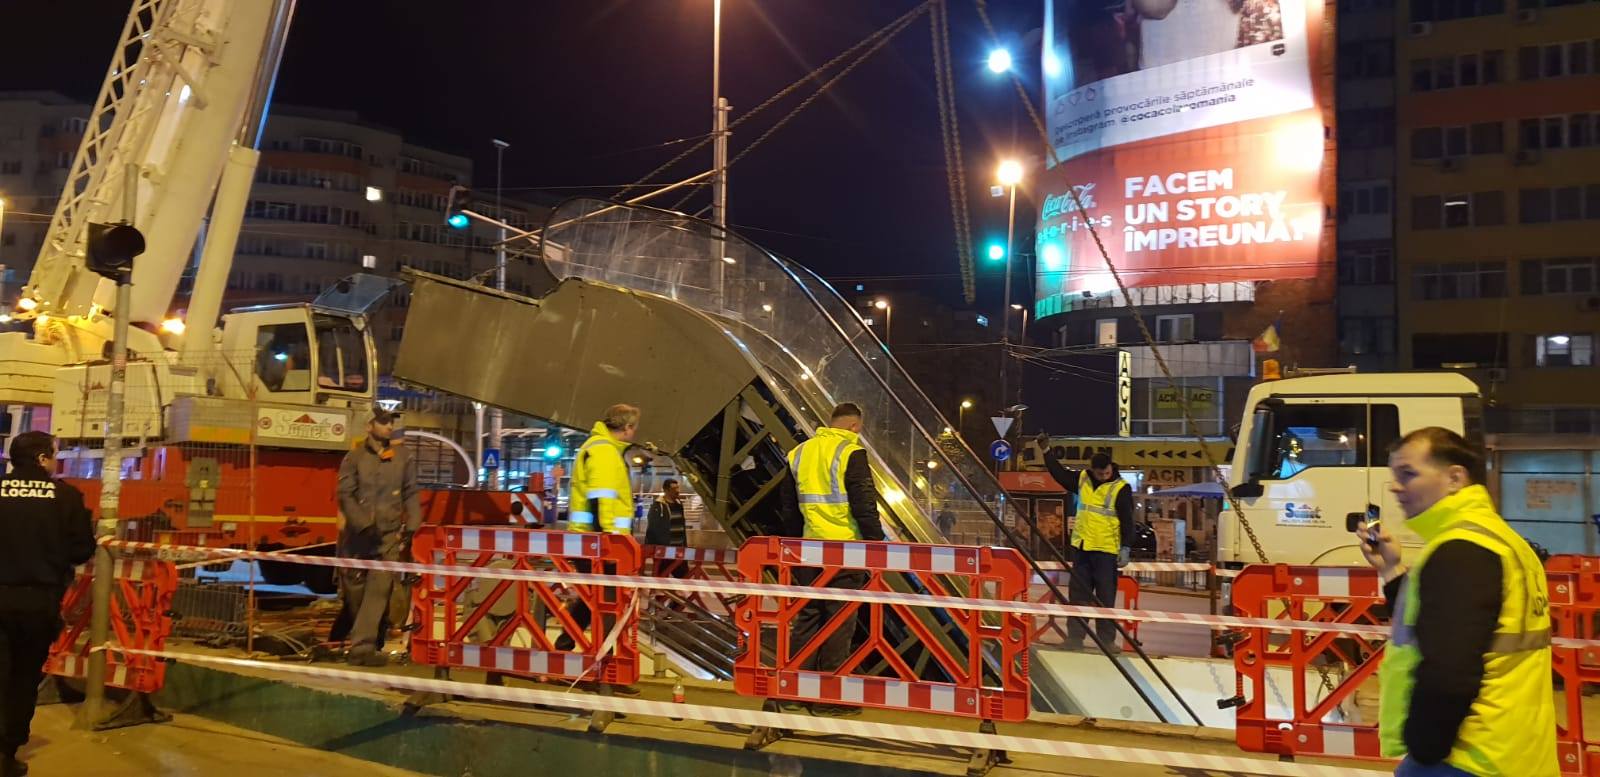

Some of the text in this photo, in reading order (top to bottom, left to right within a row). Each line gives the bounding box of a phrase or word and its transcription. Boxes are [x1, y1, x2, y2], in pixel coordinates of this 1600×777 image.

[1125, 168, 1233, 198] FACEM
[1125, 190, 1287, 225] UN STORY
[1120, 353, 1129, 432] ACR
[1147, 469, 1185, 482] ACR
[0, 488, 56, 499] LOCALA
